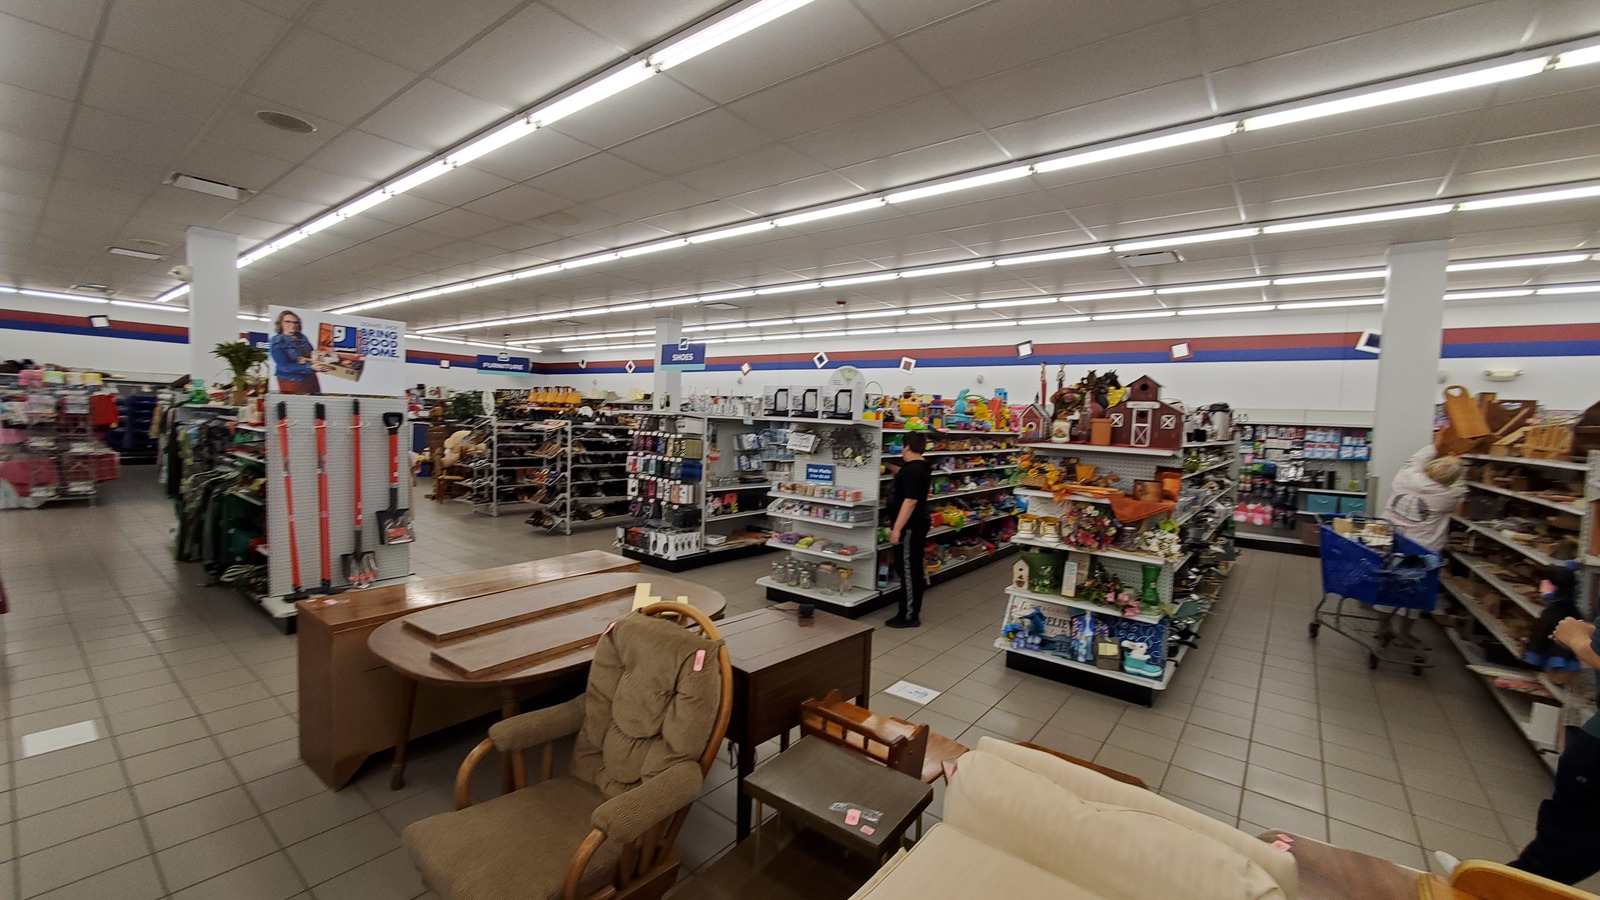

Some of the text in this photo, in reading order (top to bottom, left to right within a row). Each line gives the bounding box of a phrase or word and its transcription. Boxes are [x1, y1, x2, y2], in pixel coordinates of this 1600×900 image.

[361, 328, 398, 340] BRING
[361, 338, 398, 348] GOOD
[671, 353, 694, 362] SHOES
[482, 361, 524, 371] FURNITURE
